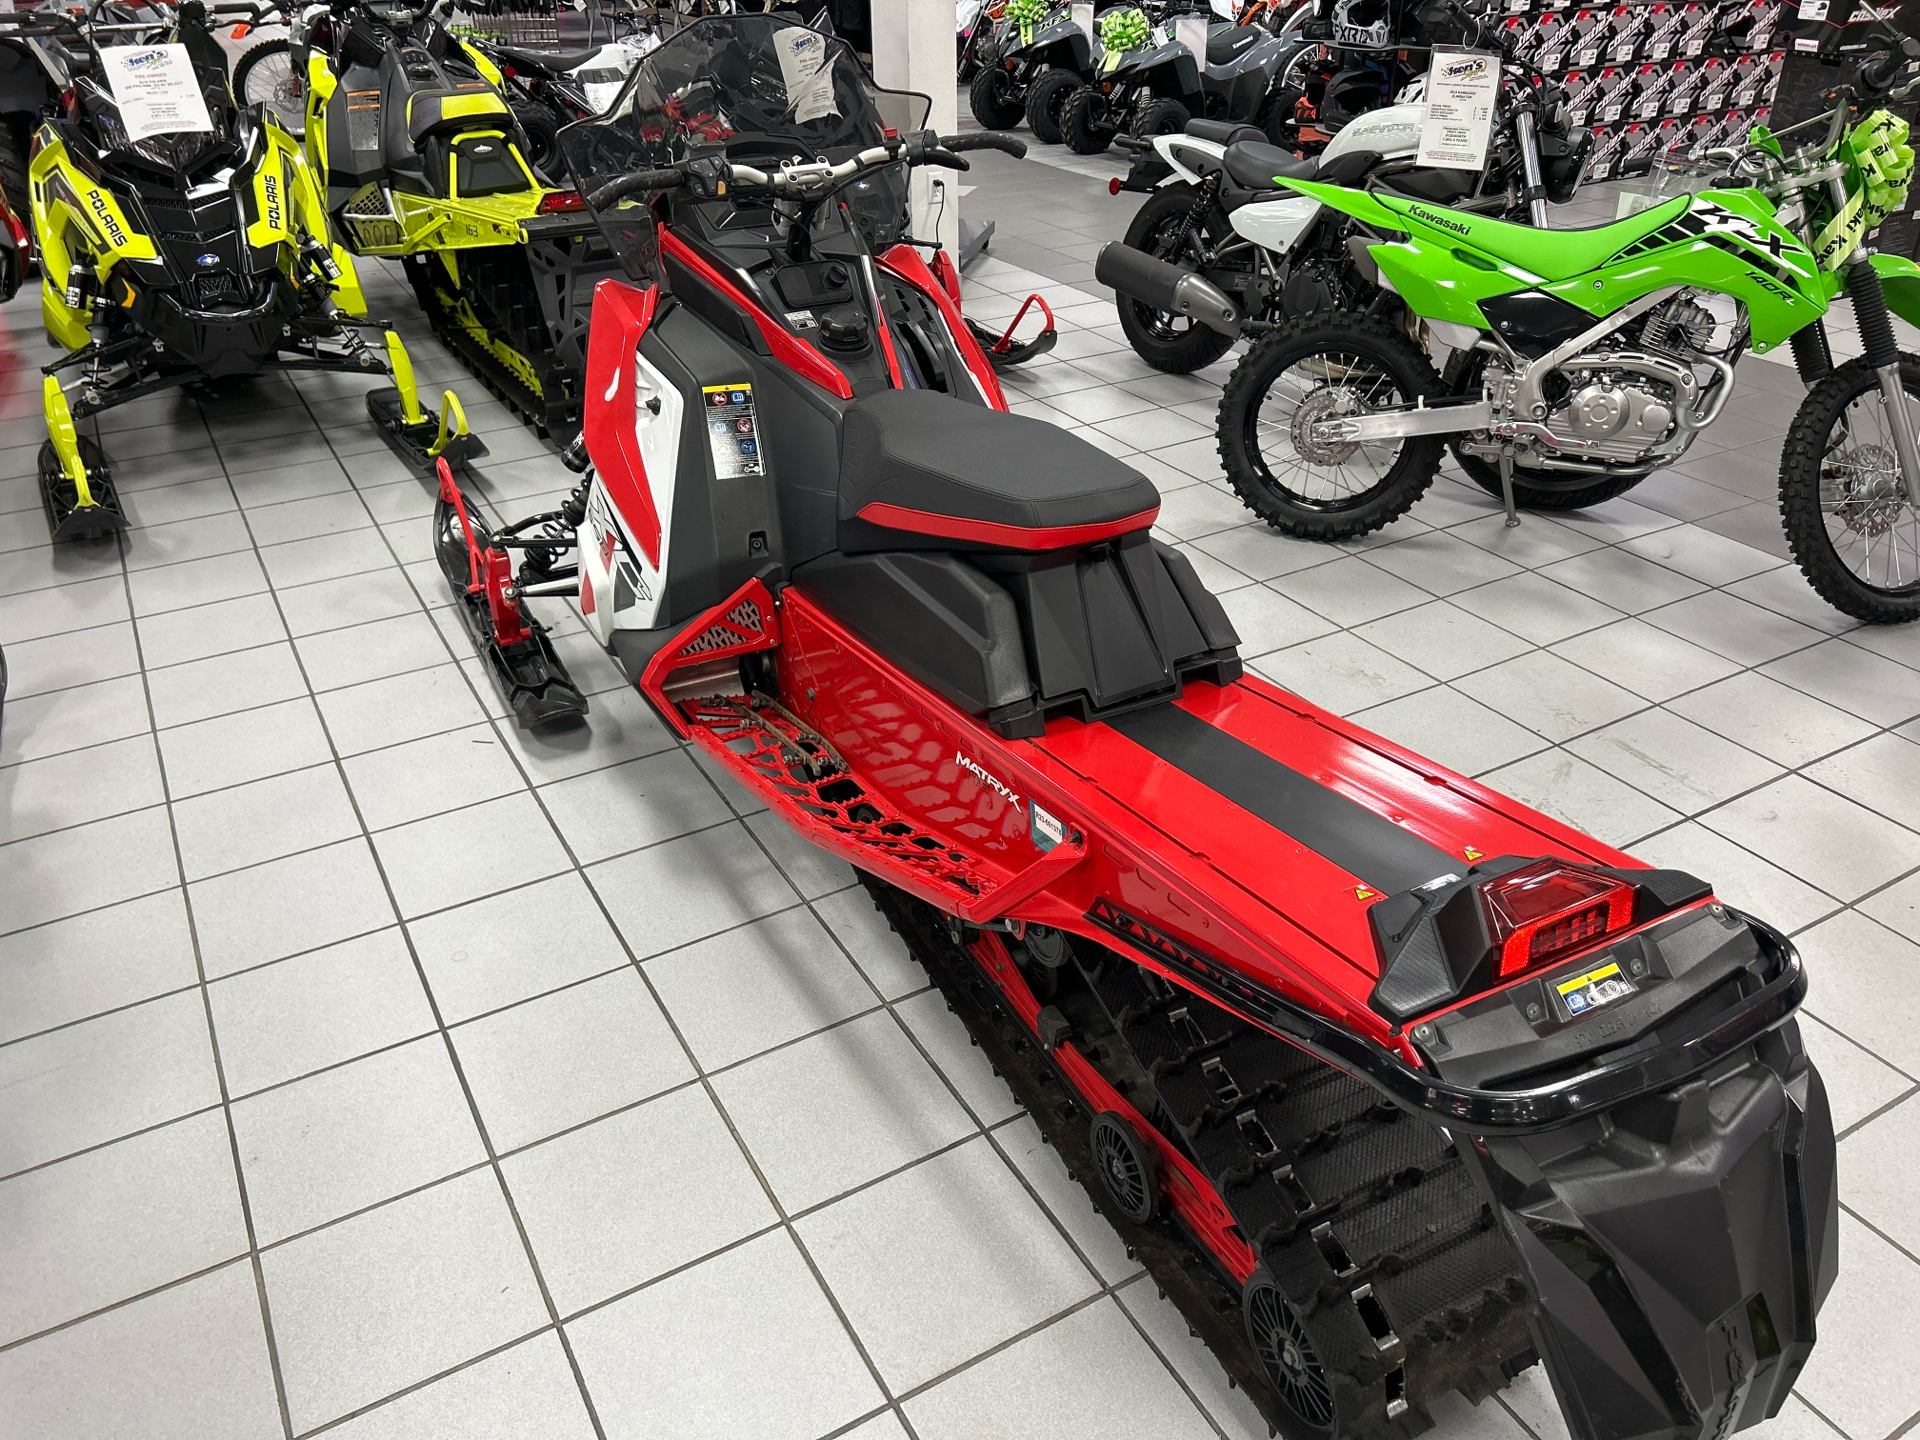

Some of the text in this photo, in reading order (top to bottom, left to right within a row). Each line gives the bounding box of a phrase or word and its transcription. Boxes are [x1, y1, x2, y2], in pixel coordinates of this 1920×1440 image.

[86, 189, 128, 247] POLARIS
[264, 174, 282, 231] POLARIS
[1408, 204, 1472, 236] Kawasaki
[955, 750, 1023, 815] MATRYX
